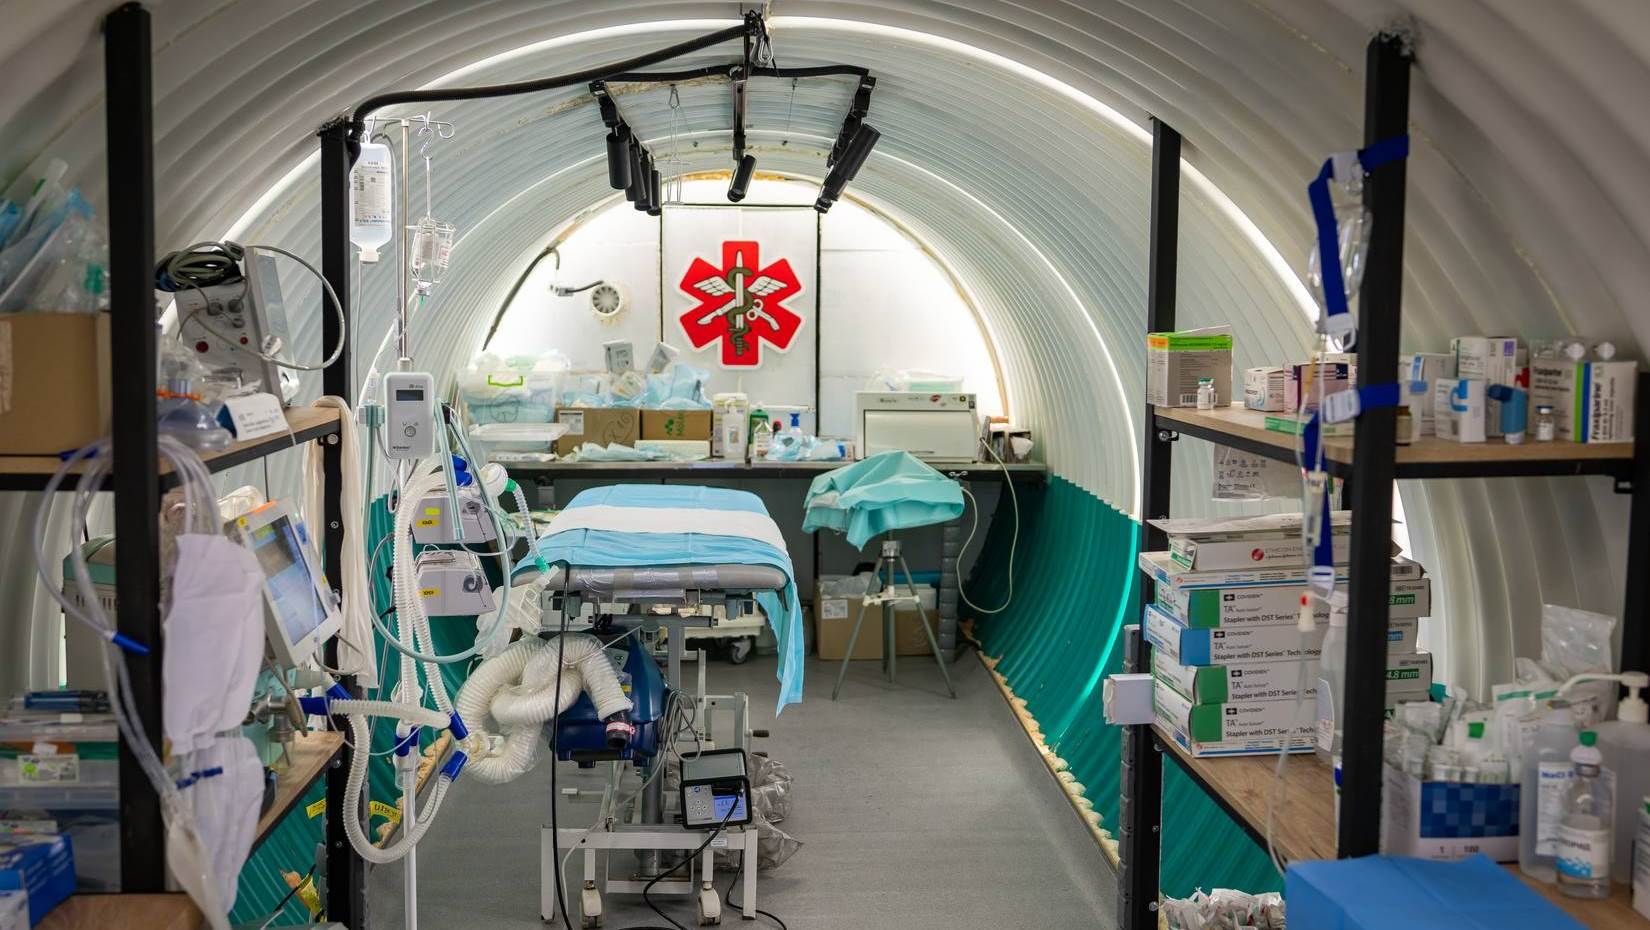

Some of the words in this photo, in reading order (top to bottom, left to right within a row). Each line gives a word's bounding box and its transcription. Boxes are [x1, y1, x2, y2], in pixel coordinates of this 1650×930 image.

[1224, 615, 1246, 624] Stapler
[1247, 613, 1260, 622] with
[1262, 612, 1274, 621] DST
[1214, 652, 1235, 661] Stapler
[1237, 650, 1250, 659] with
[1251, 650, 1264, 658] DST
[1232, 691, 1252, 700] Stapler
[1254, 690, 1267, 698] with
[1268, 689, 1281, 698] DST
[1226, 729, 1247, 739] Stapler
[1249, 729, 1262, 737] with
[1264, 727, 1277, 736] DST
